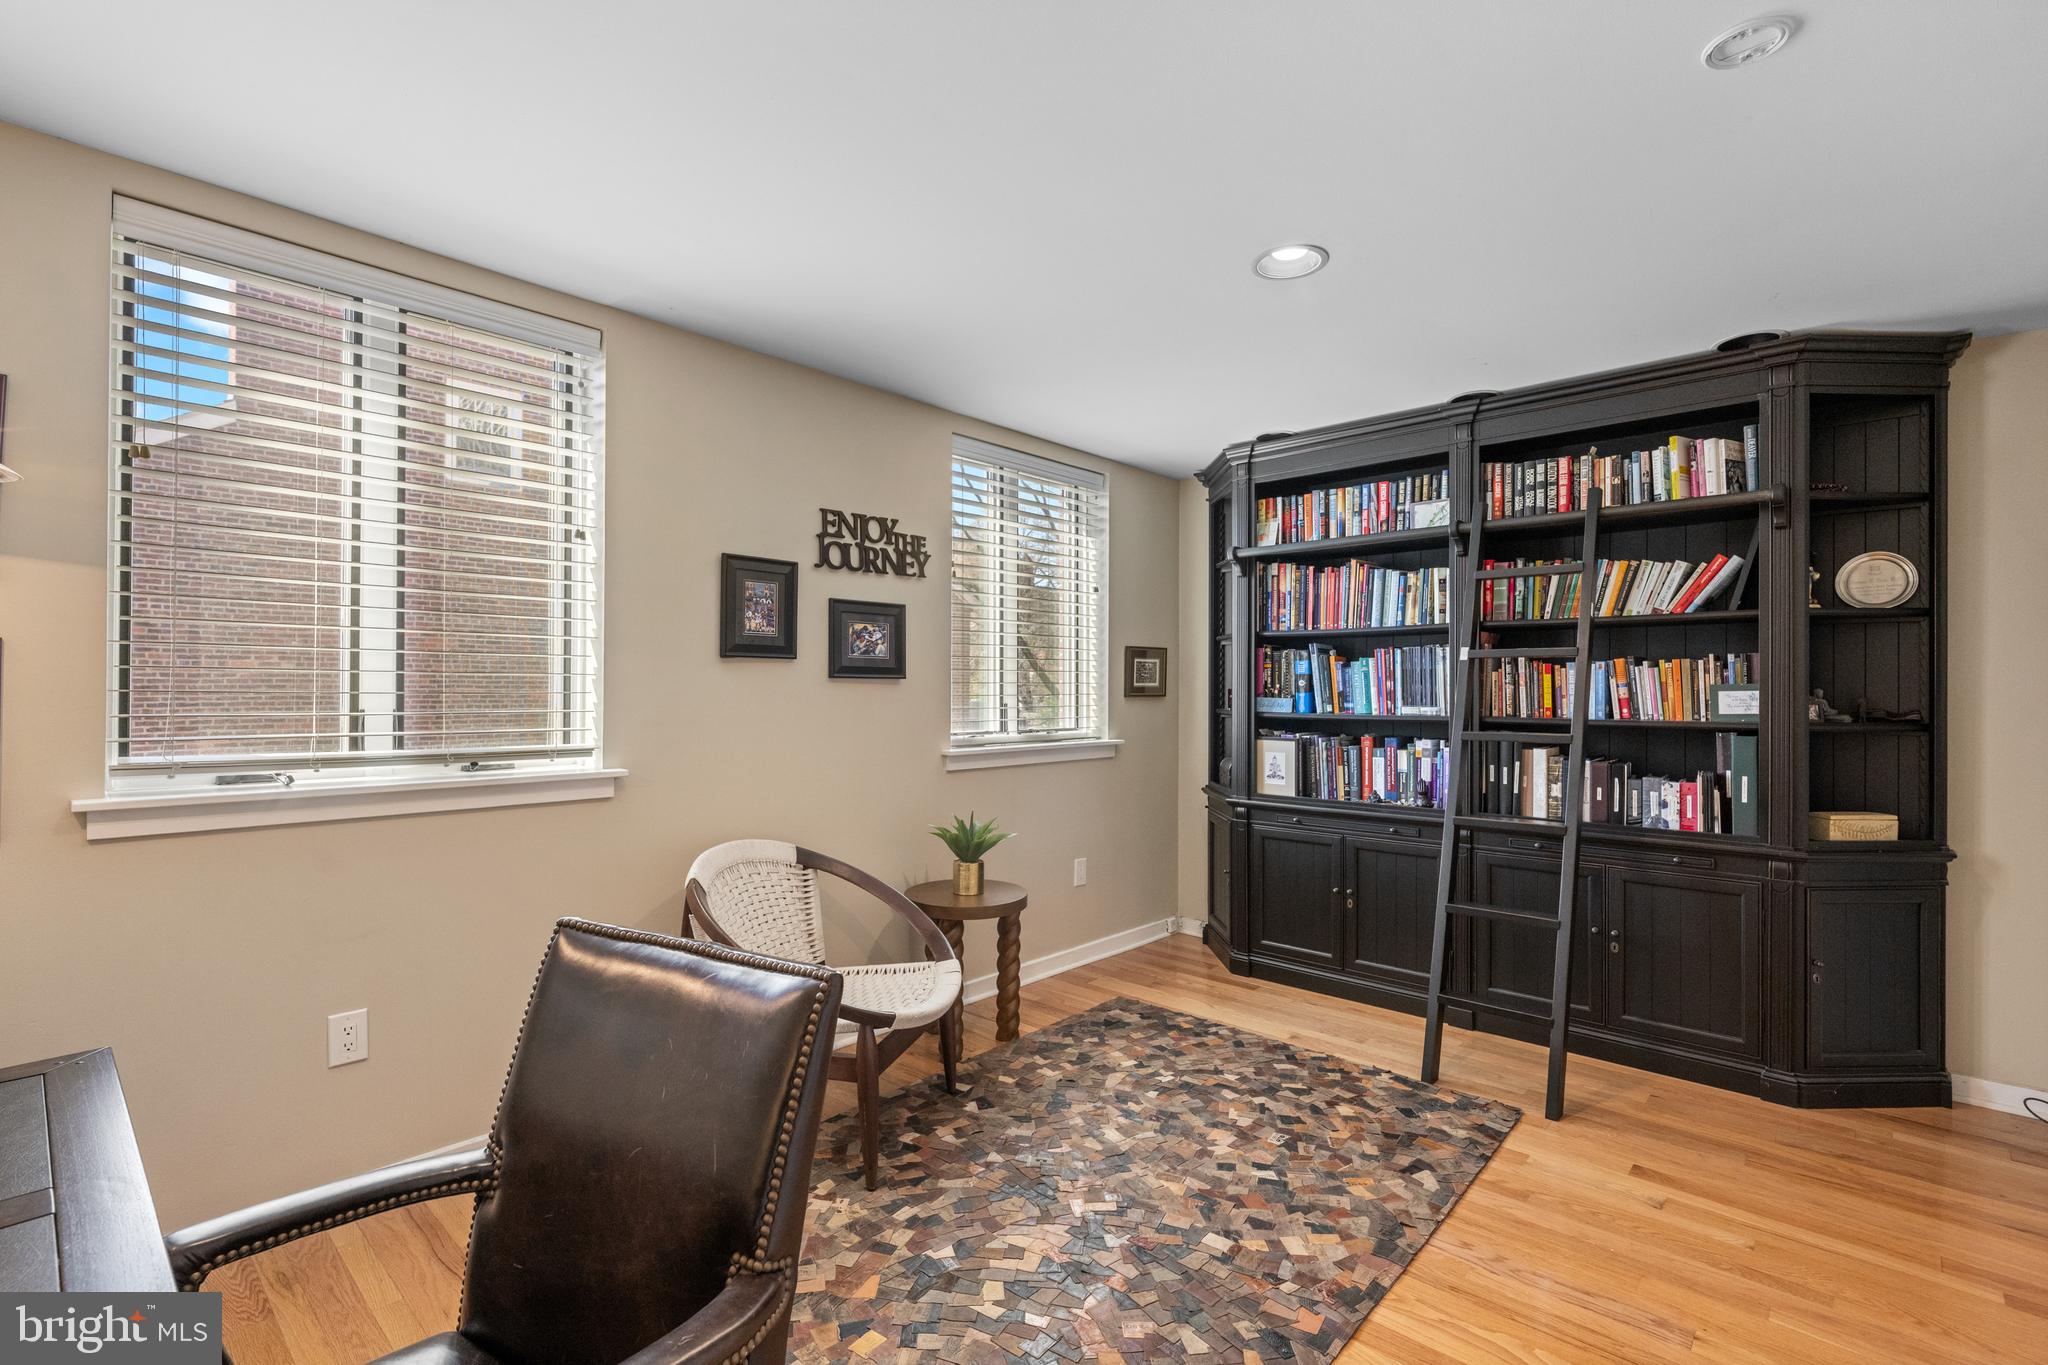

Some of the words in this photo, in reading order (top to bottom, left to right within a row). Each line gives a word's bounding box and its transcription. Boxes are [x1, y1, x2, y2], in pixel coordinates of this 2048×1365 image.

[819, 508, 898, 546] ENJOY
[894, 532, 927, 555] THE
[814, 533, 932, 578] JOURNEY
